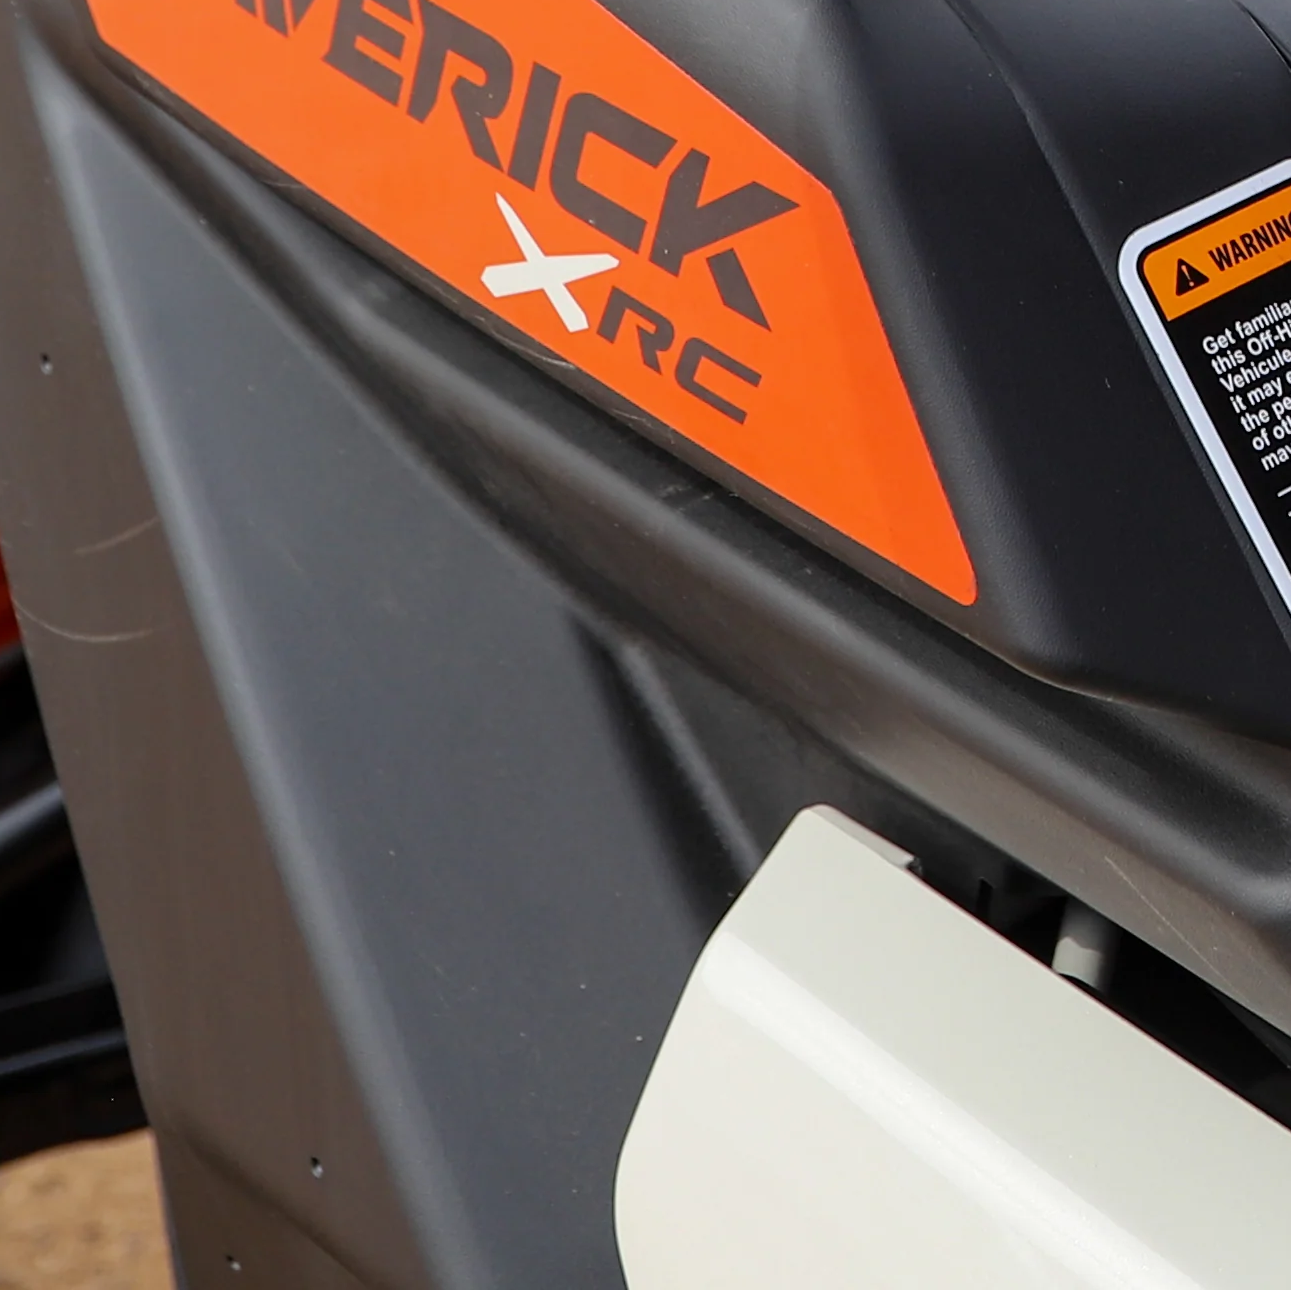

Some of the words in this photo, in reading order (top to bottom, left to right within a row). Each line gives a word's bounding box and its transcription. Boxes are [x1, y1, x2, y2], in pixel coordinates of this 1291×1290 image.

[1203, 328, 1236, 354] Get
[1211, 349, 1246, 374] this
[1230, 395, 1246, 413] it
[1247, 377, 1282, 405] may
[1240, 409, 1270, 432] the
[1252, 428, 1270, 450] of
